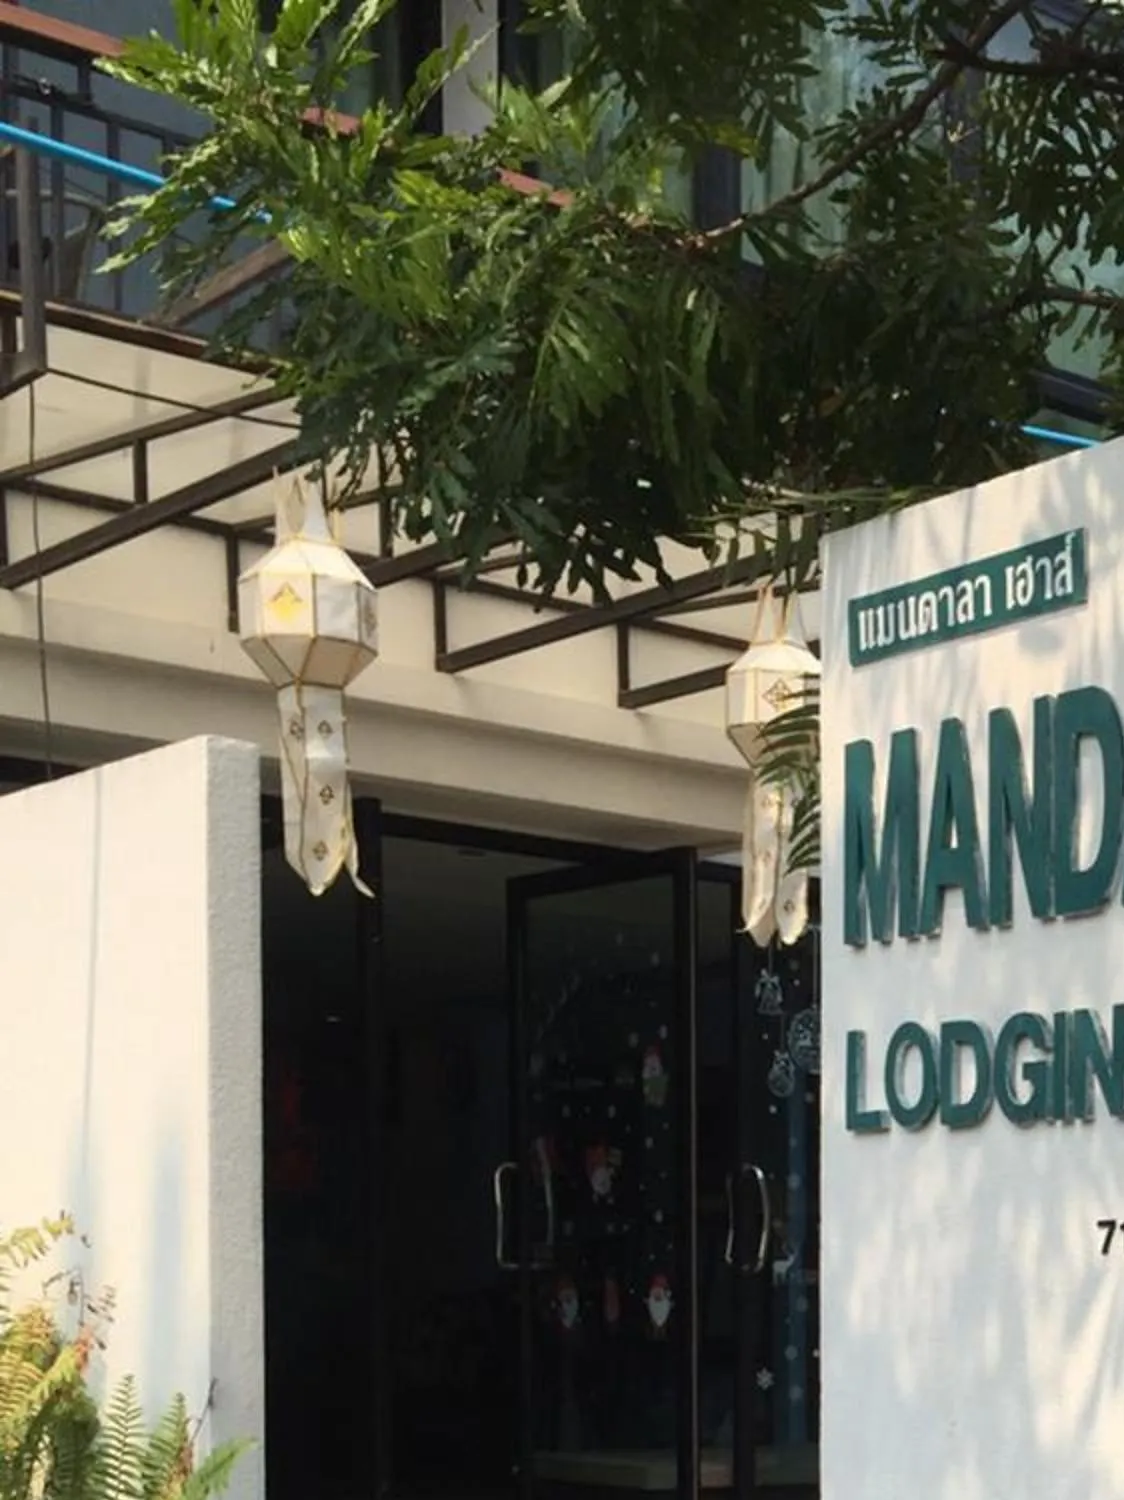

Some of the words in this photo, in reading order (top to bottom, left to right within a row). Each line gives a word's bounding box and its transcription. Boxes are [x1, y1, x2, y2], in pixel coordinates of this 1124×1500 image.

[857, 573, 993, 652] แมนดาลา
[1004, 532, 1076, 610] เฮาส์
